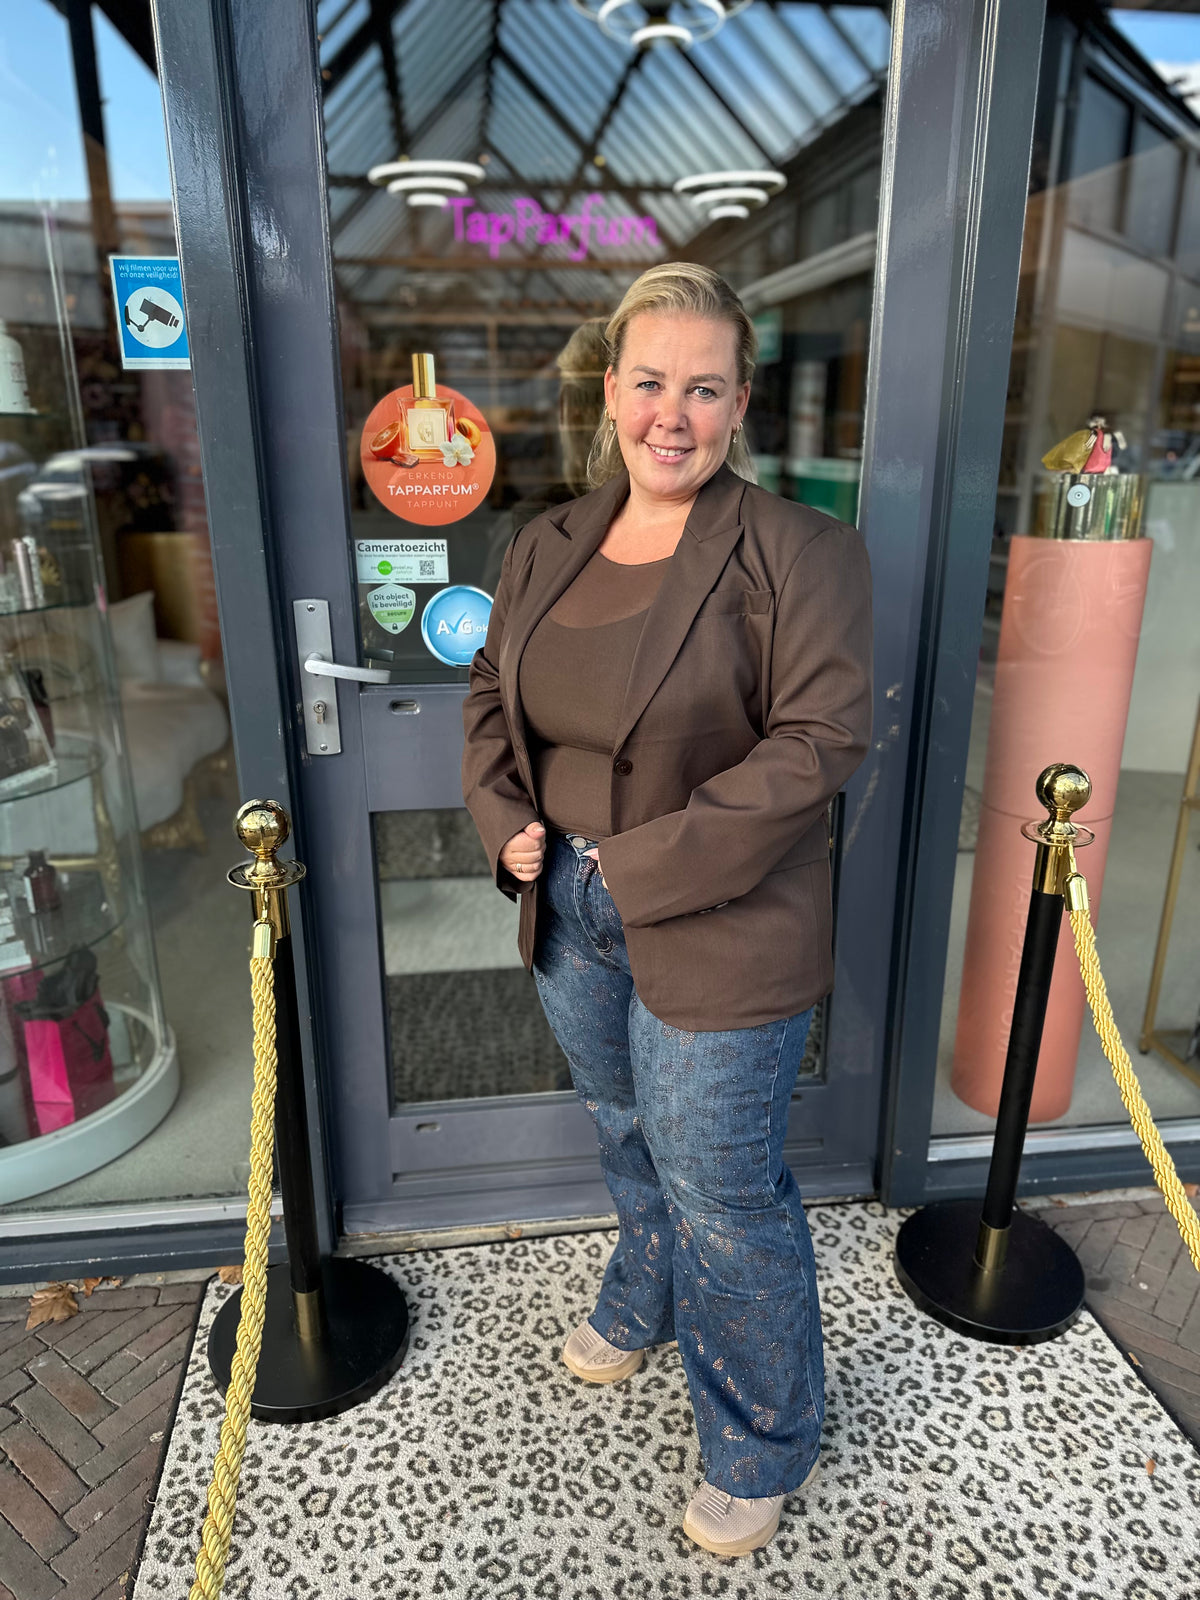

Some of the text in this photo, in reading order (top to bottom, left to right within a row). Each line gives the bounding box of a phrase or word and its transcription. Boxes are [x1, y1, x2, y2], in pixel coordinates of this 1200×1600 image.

[443, 193, 661, 262] TapParfum
[119, 264, 129, 272] Wij
[130, 264, 151, 272] filmen
[408, 472, 454, 480] ERKEND
[407, 500, 459, 508] TAPPUNT
[357, 542, 446, 552] Cameratoezicht
[373, 592, 409, 601] Dit object
[380, 600, 413, 608] beveiligd
